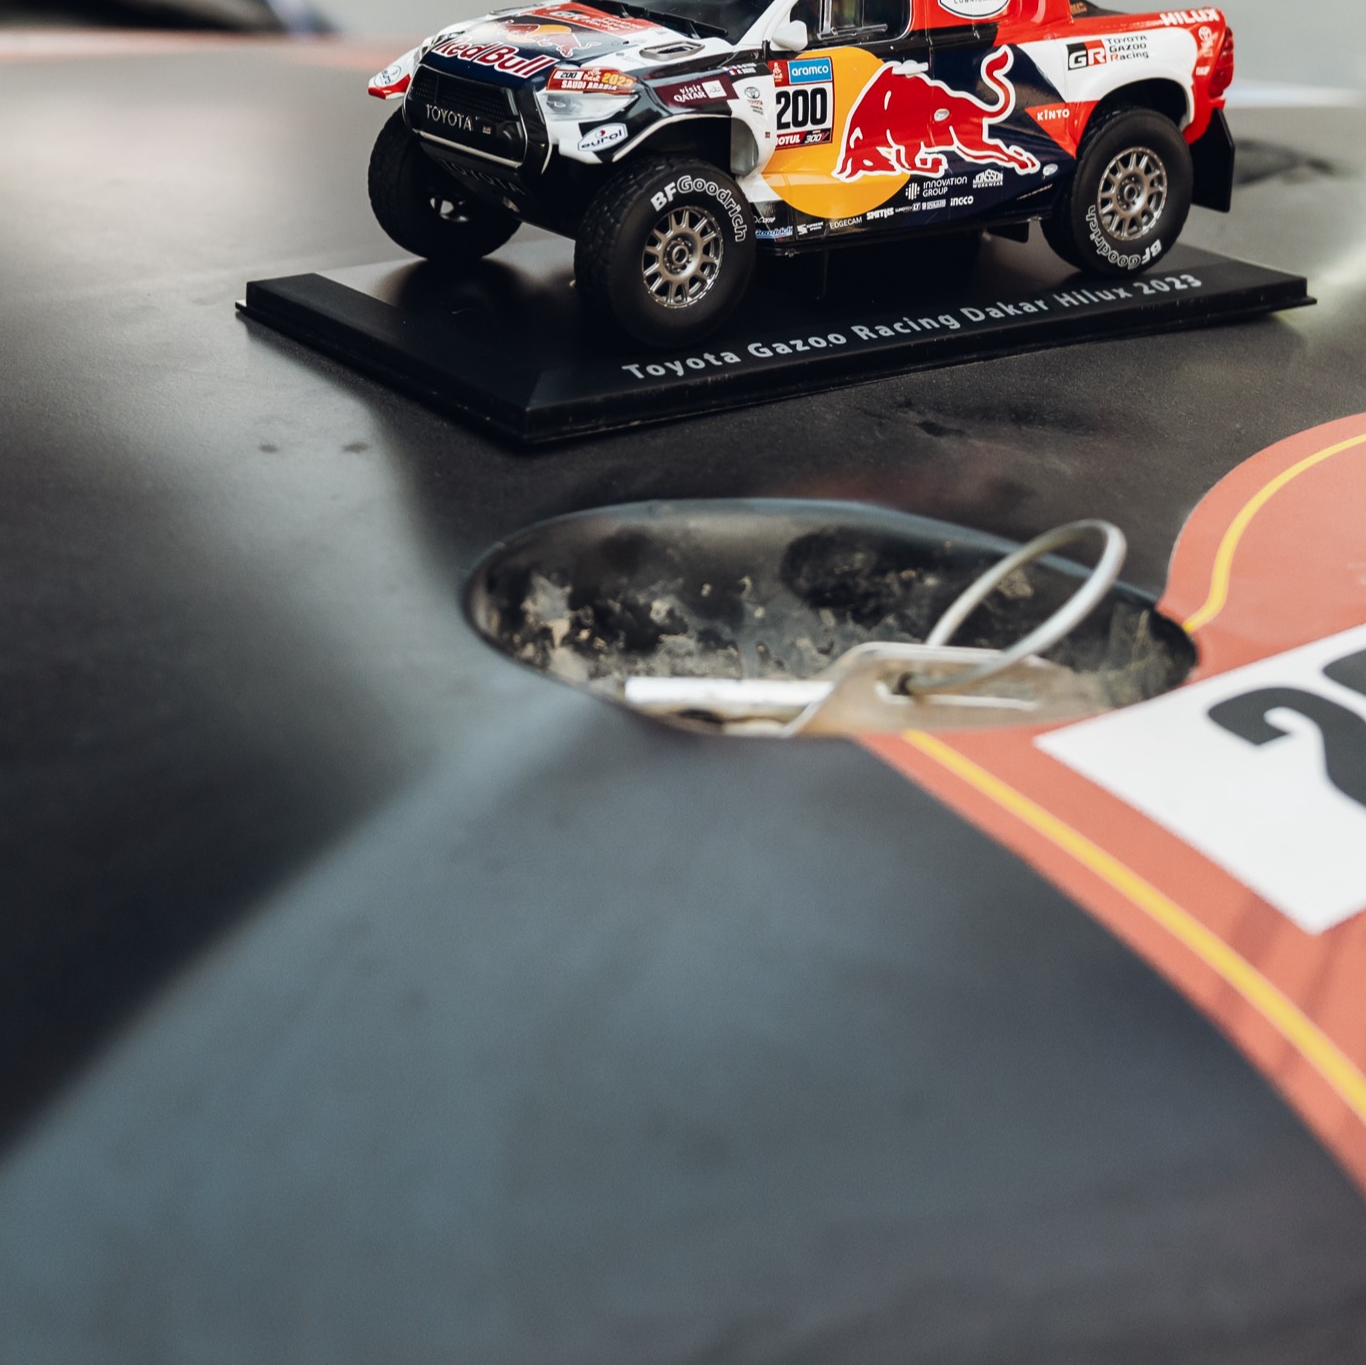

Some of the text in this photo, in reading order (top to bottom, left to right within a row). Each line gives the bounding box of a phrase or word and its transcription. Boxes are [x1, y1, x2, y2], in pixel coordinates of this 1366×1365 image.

[1159, 8, 1221, 26] HILUX
[1105, 34, 1148, 45] TOYOTA
[1108, 42, 1147, 53] GAZOO
[1067, 47, 1107, 71] GR
[1110, 50, 1150, 62] Racing
[791, 62, 829, 77] aramco
[561, 80, 618, 91] SAUDI ARABIA
[679, 84, 702, 94] visit
[673, 91, 707, 102] QATAR
[775, 87, 828, 130] 200
[426, 103, 473, 132] TOYOTA
[580, 128, 623, 149] eurol
[922, 186, 949, 197] GROUP
[829, 216, 863, 230] EDGECAM
[621, 274, 1203, 379] Toyota Gazoo Racing Dakar Hilux 2023
